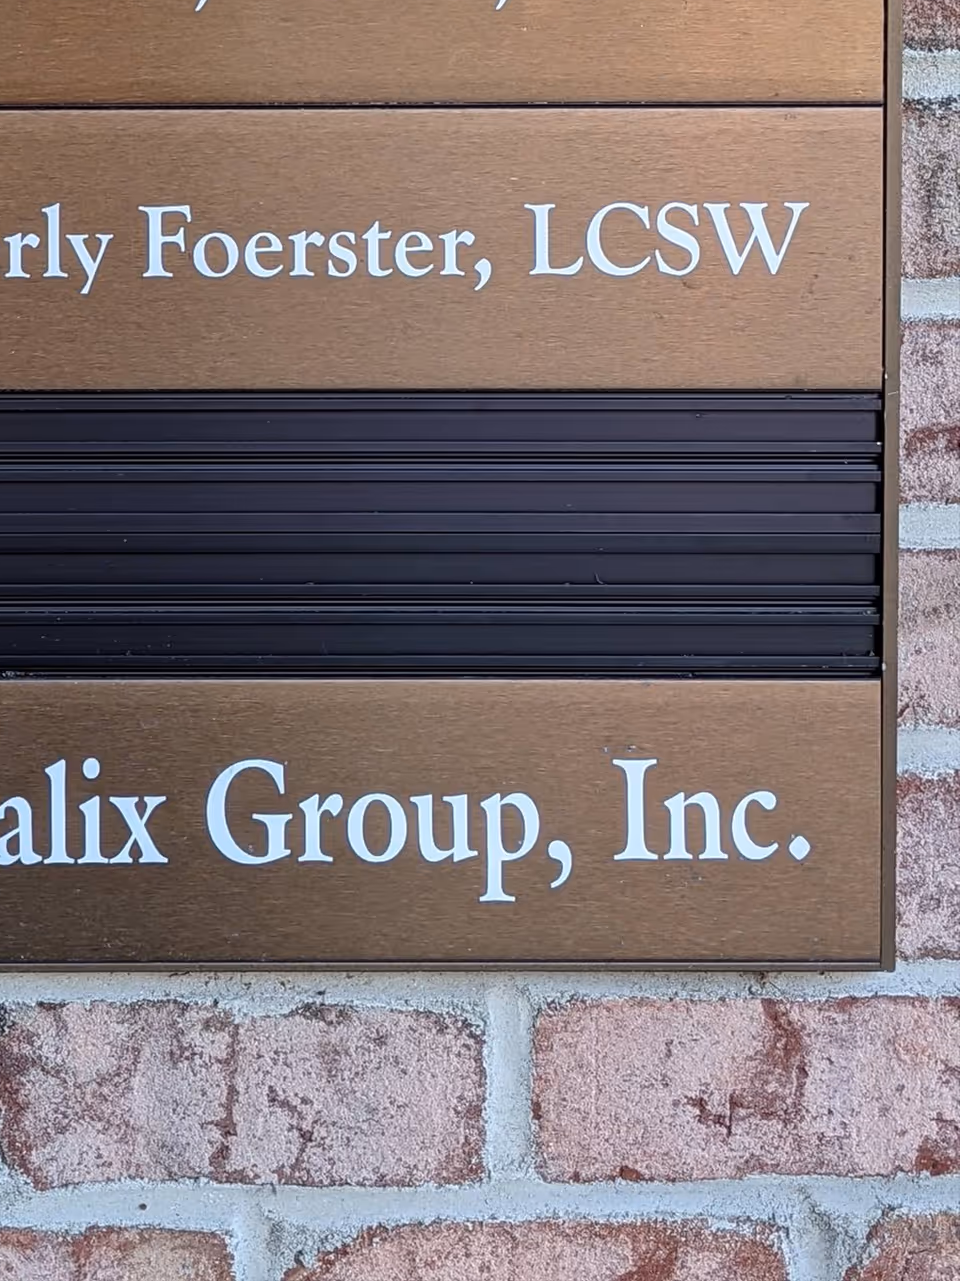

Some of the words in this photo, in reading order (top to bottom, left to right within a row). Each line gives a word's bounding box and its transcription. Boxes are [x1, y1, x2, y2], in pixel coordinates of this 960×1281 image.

[138, 205, 492, 292] Foerster,
[524, 202, 810, 277] LCSW
[206, 758, 573, 903] Group,
[611, 757, 812, 862] Inc.
